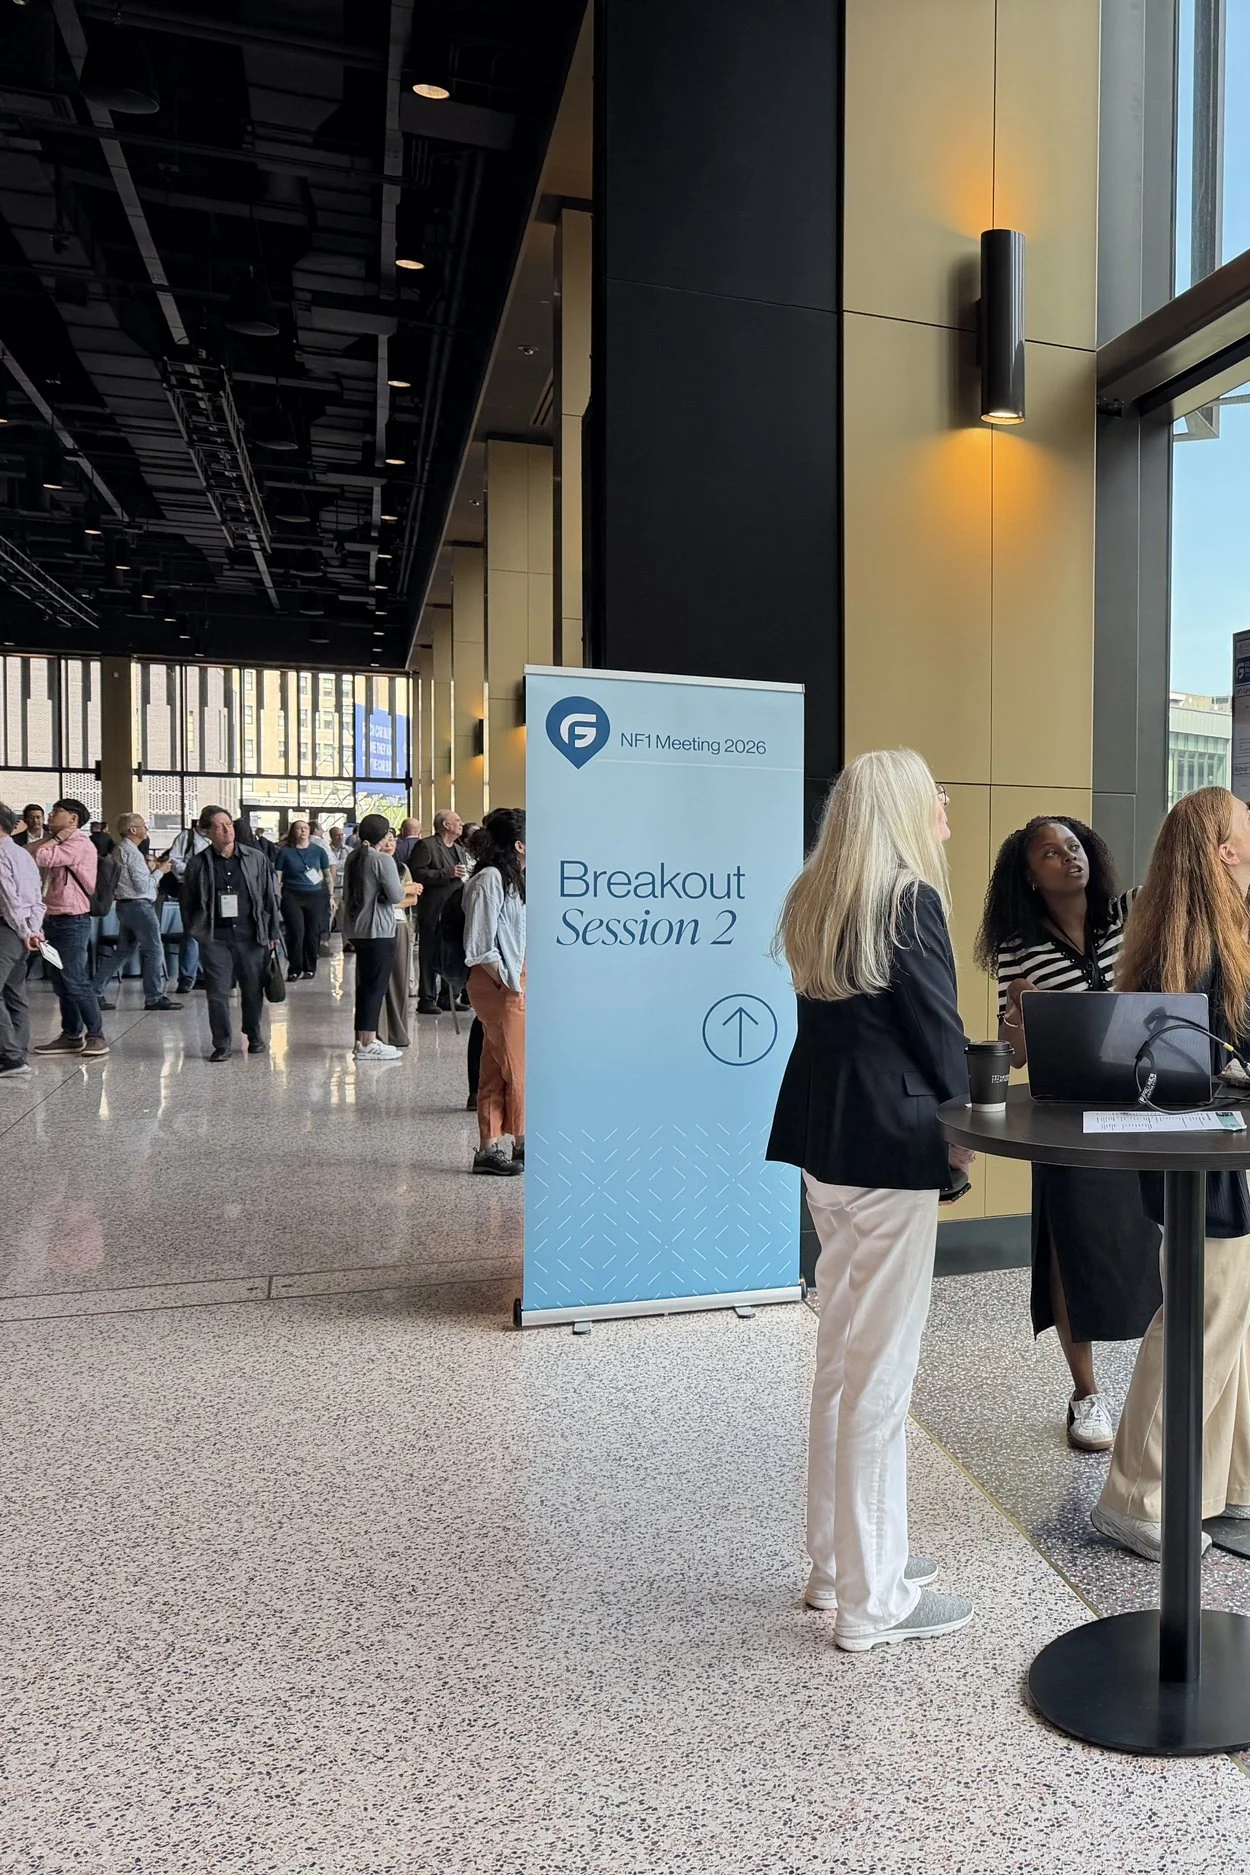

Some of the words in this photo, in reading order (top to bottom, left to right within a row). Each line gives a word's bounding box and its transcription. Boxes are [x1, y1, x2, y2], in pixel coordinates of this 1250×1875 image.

[620, 732, 652, 749] NF1
[656, 735, 721, 755] Meeting
[724, 738, 767, 755] 2026
[559, 860, 746, 900] Breakout
[556, 908, 701, 946] Session
[710, 909, 738, 946] 2
